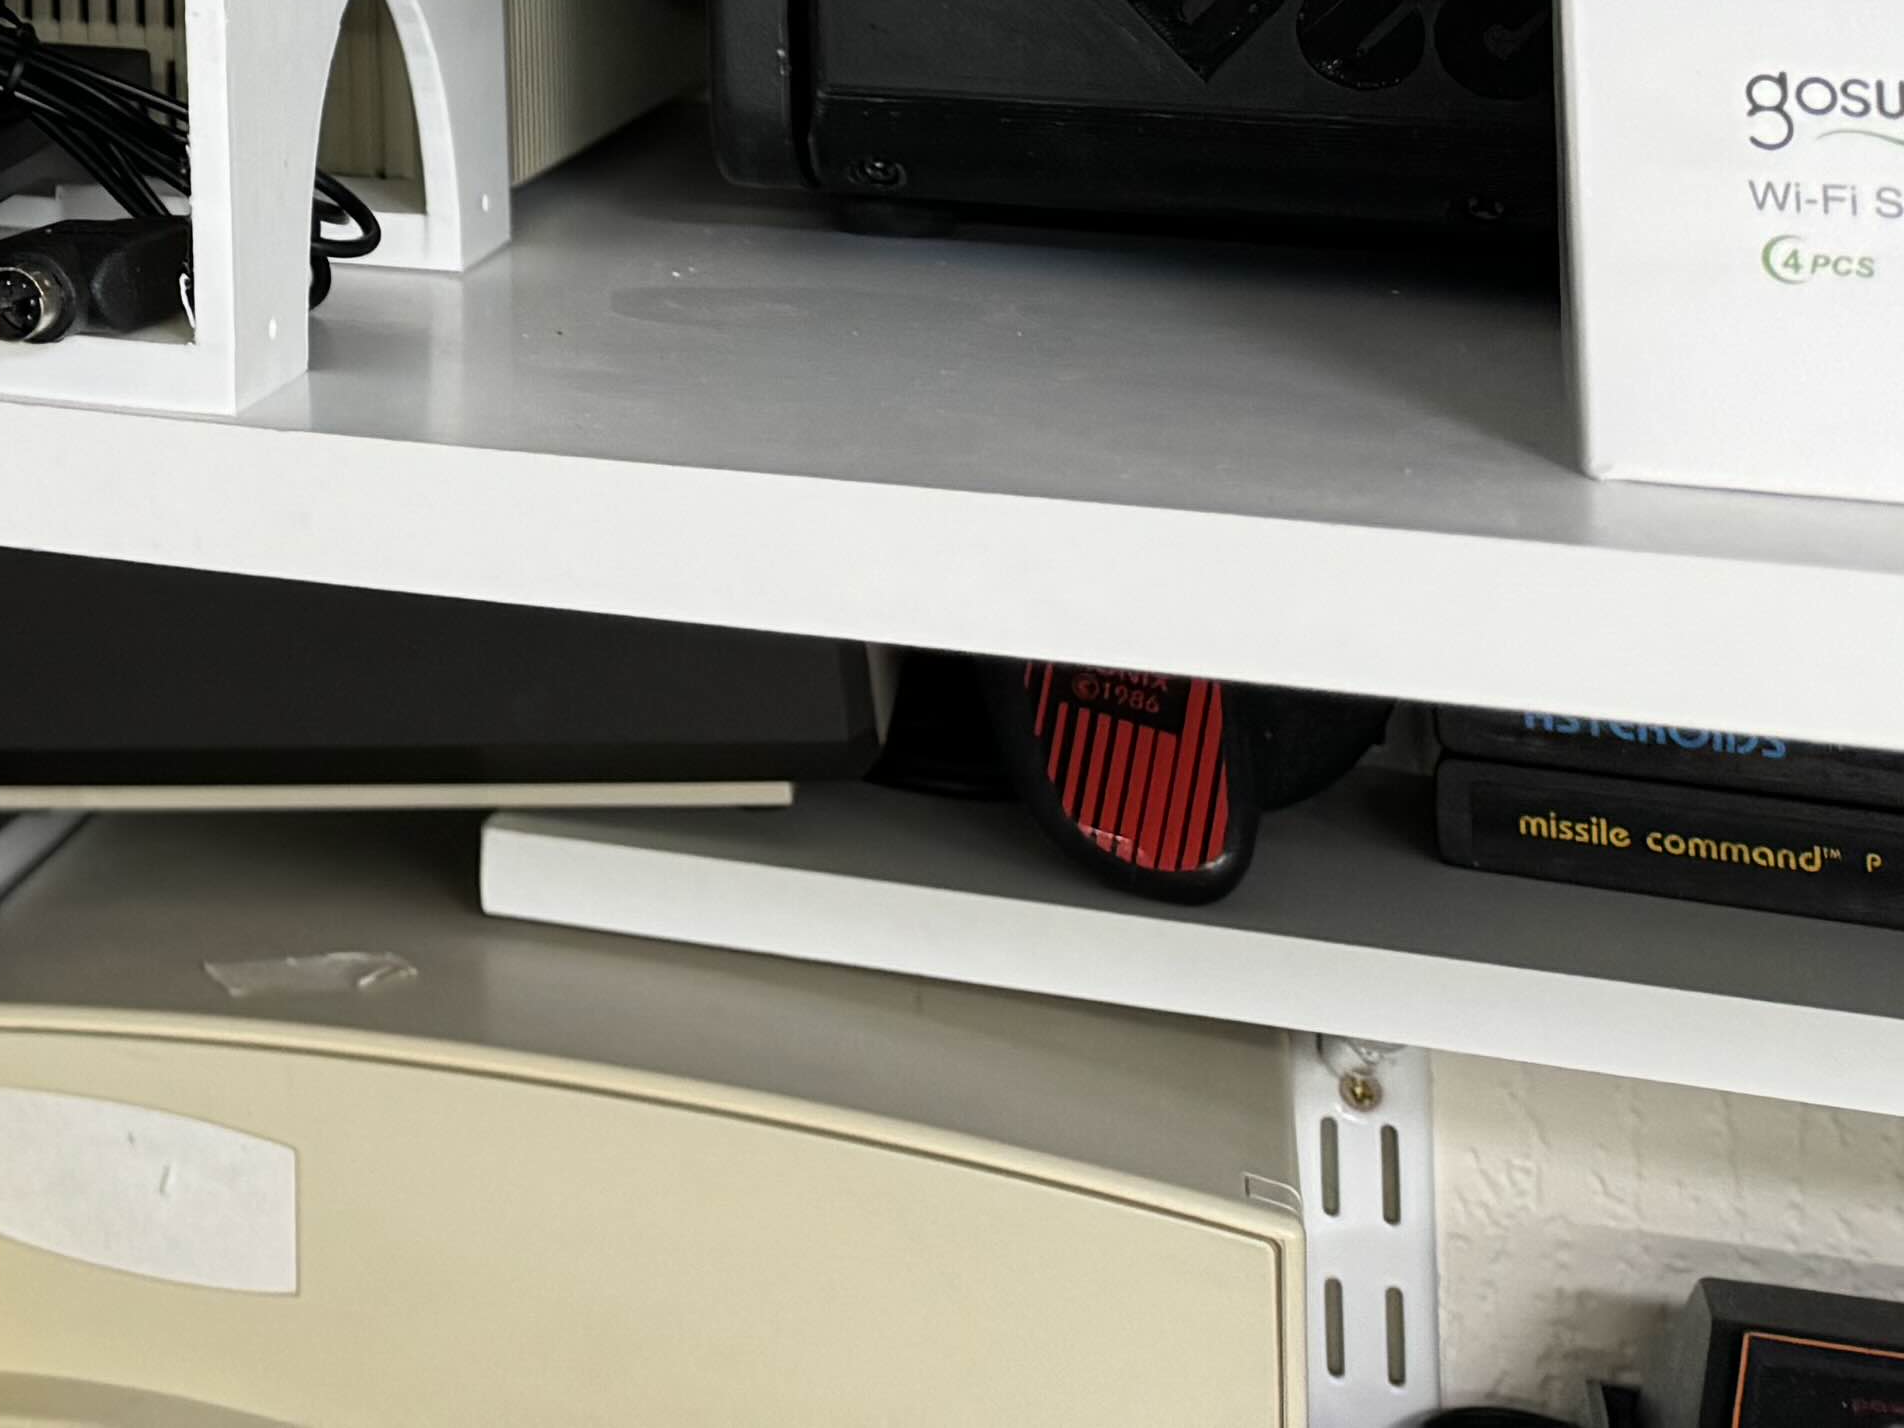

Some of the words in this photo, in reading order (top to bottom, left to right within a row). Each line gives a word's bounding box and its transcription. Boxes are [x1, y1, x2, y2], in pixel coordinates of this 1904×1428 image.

[1748, 179, 1859, 217] Wi-Fi
[1781, 247, 1803, 275] 4
[1810, 252, 1876, 279] PCS
[1519, 812, 1632, 848] missile
